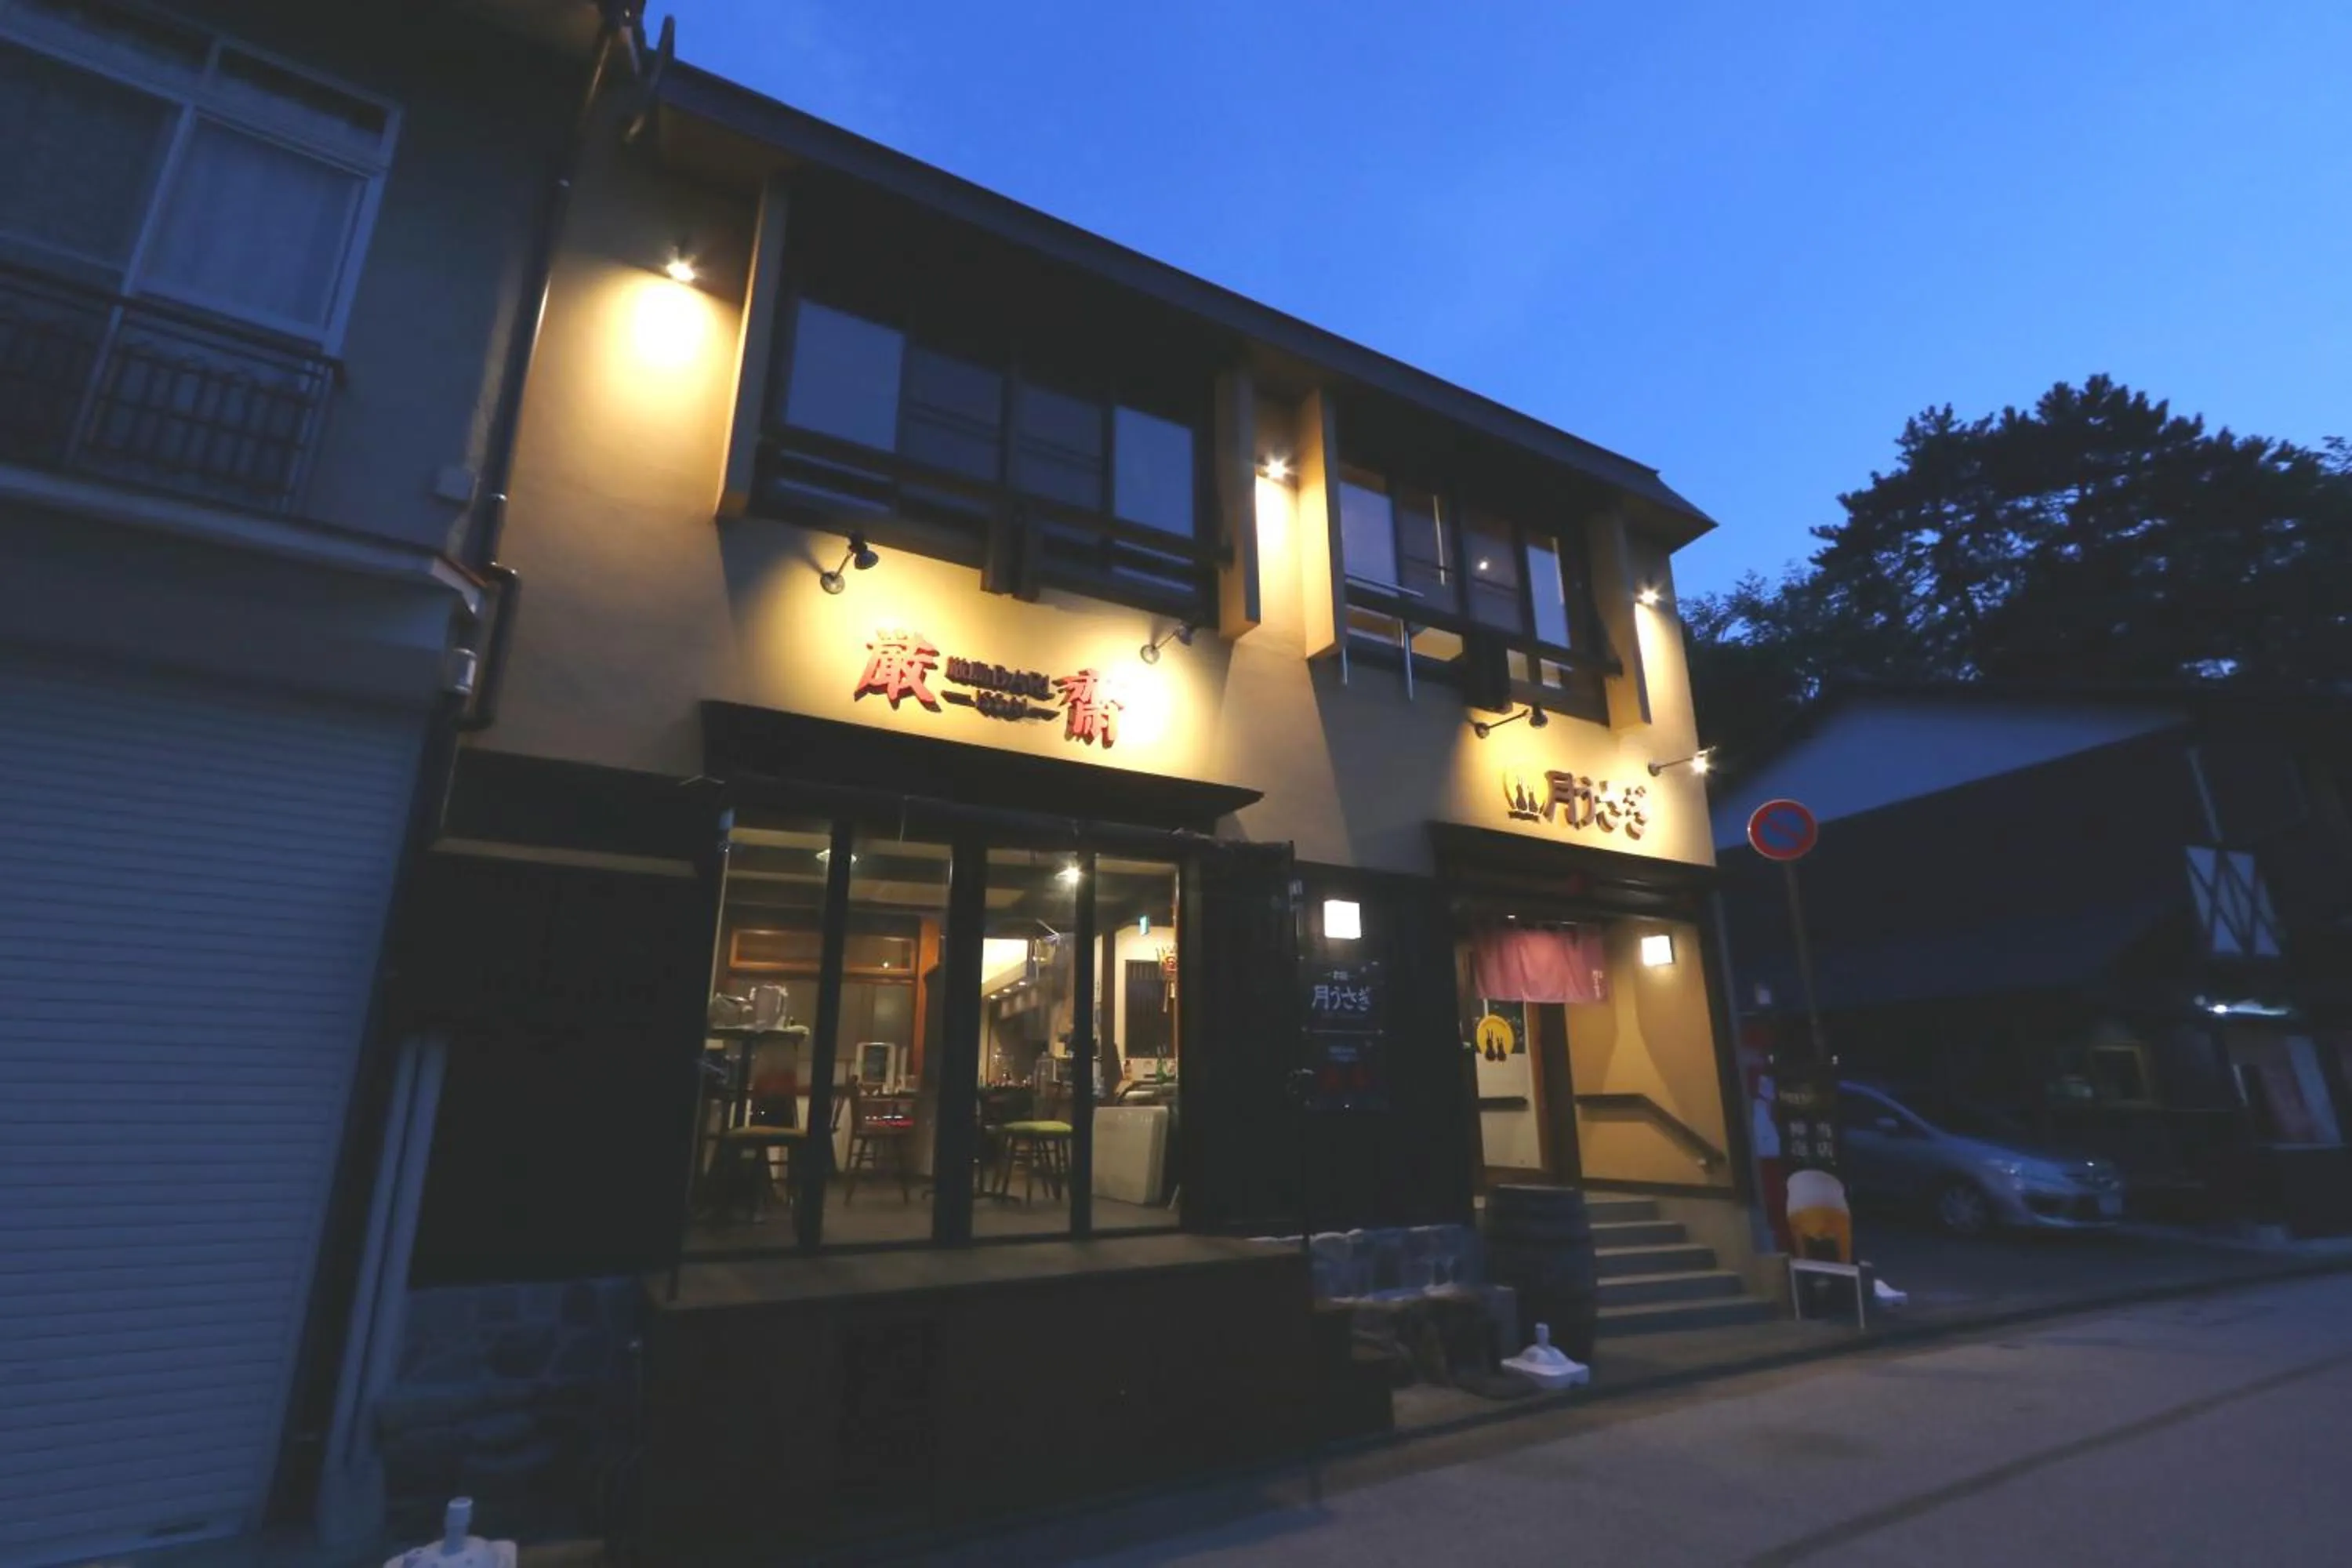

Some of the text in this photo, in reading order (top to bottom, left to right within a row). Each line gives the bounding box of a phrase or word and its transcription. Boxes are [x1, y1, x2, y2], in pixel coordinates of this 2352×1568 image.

[1544, 770, 1646, 840] 月うさぎ
[1312, 985, 1372, 1011] 月うさぎ
